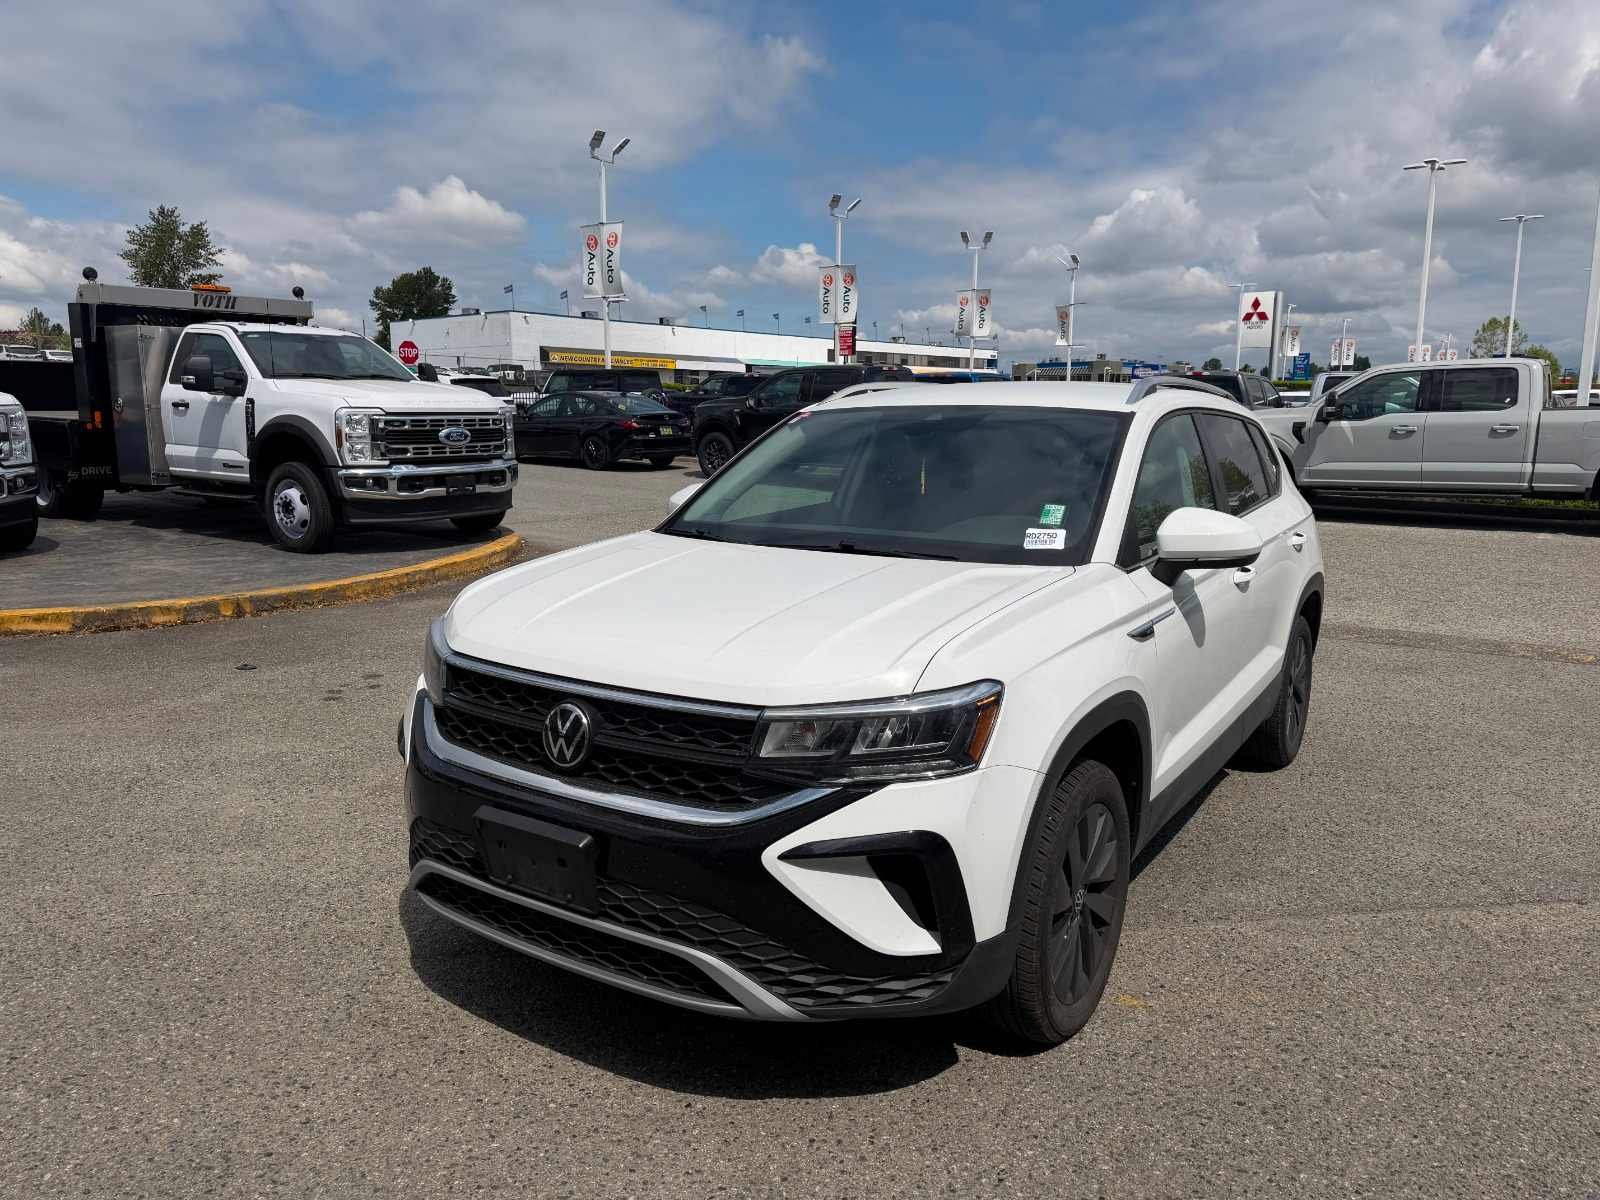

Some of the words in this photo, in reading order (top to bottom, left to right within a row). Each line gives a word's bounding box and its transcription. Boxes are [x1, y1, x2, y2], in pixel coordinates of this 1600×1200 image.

[587, 251, 596, 286] Auto
[606, 249, 614, 284] Auto
[193, 293, 238, 310] VOTH
[823, 287, 831, 314] Auto
[843, 285, 852, 313] Auto
[958, 307, 966, 330] Auto
[399, 347, 418, 358] STOP
[81, 465, 113, 475] DRIVE
[546, 706, 586, 762] VW
